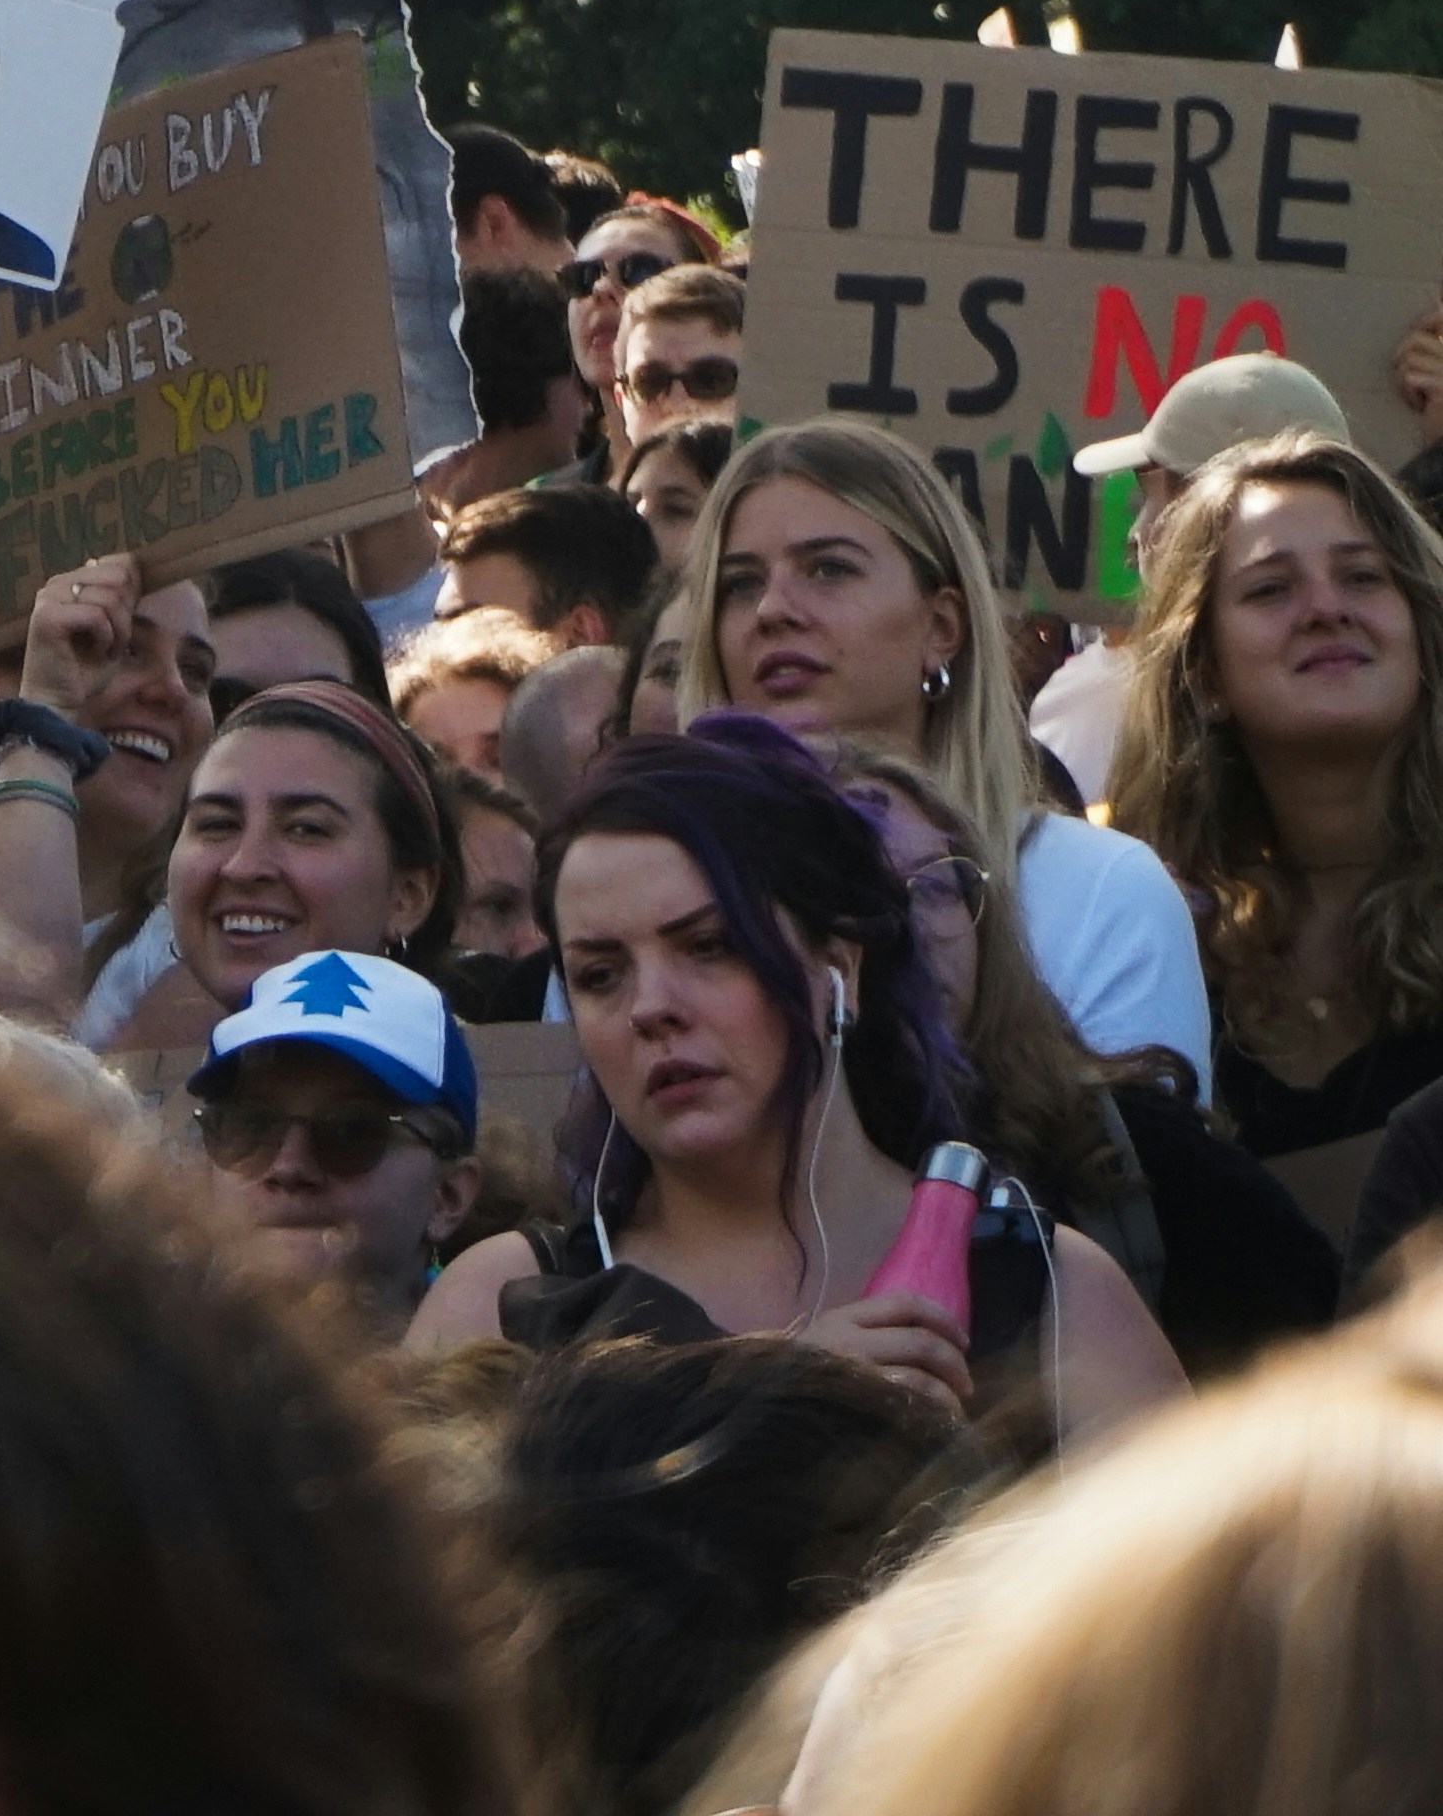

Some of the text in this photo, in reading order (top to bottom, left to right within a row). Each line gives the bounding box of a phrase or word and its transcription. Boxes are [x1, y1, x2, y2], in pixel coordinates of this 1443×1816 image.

[78, 85, 276, 221] OU BUY
[780, 66, 1362, 272] THERE
[159, 362, 268, 456] YOU
[827, 272, 1026, 418] IS
[250, 391, 386, 499] HER
